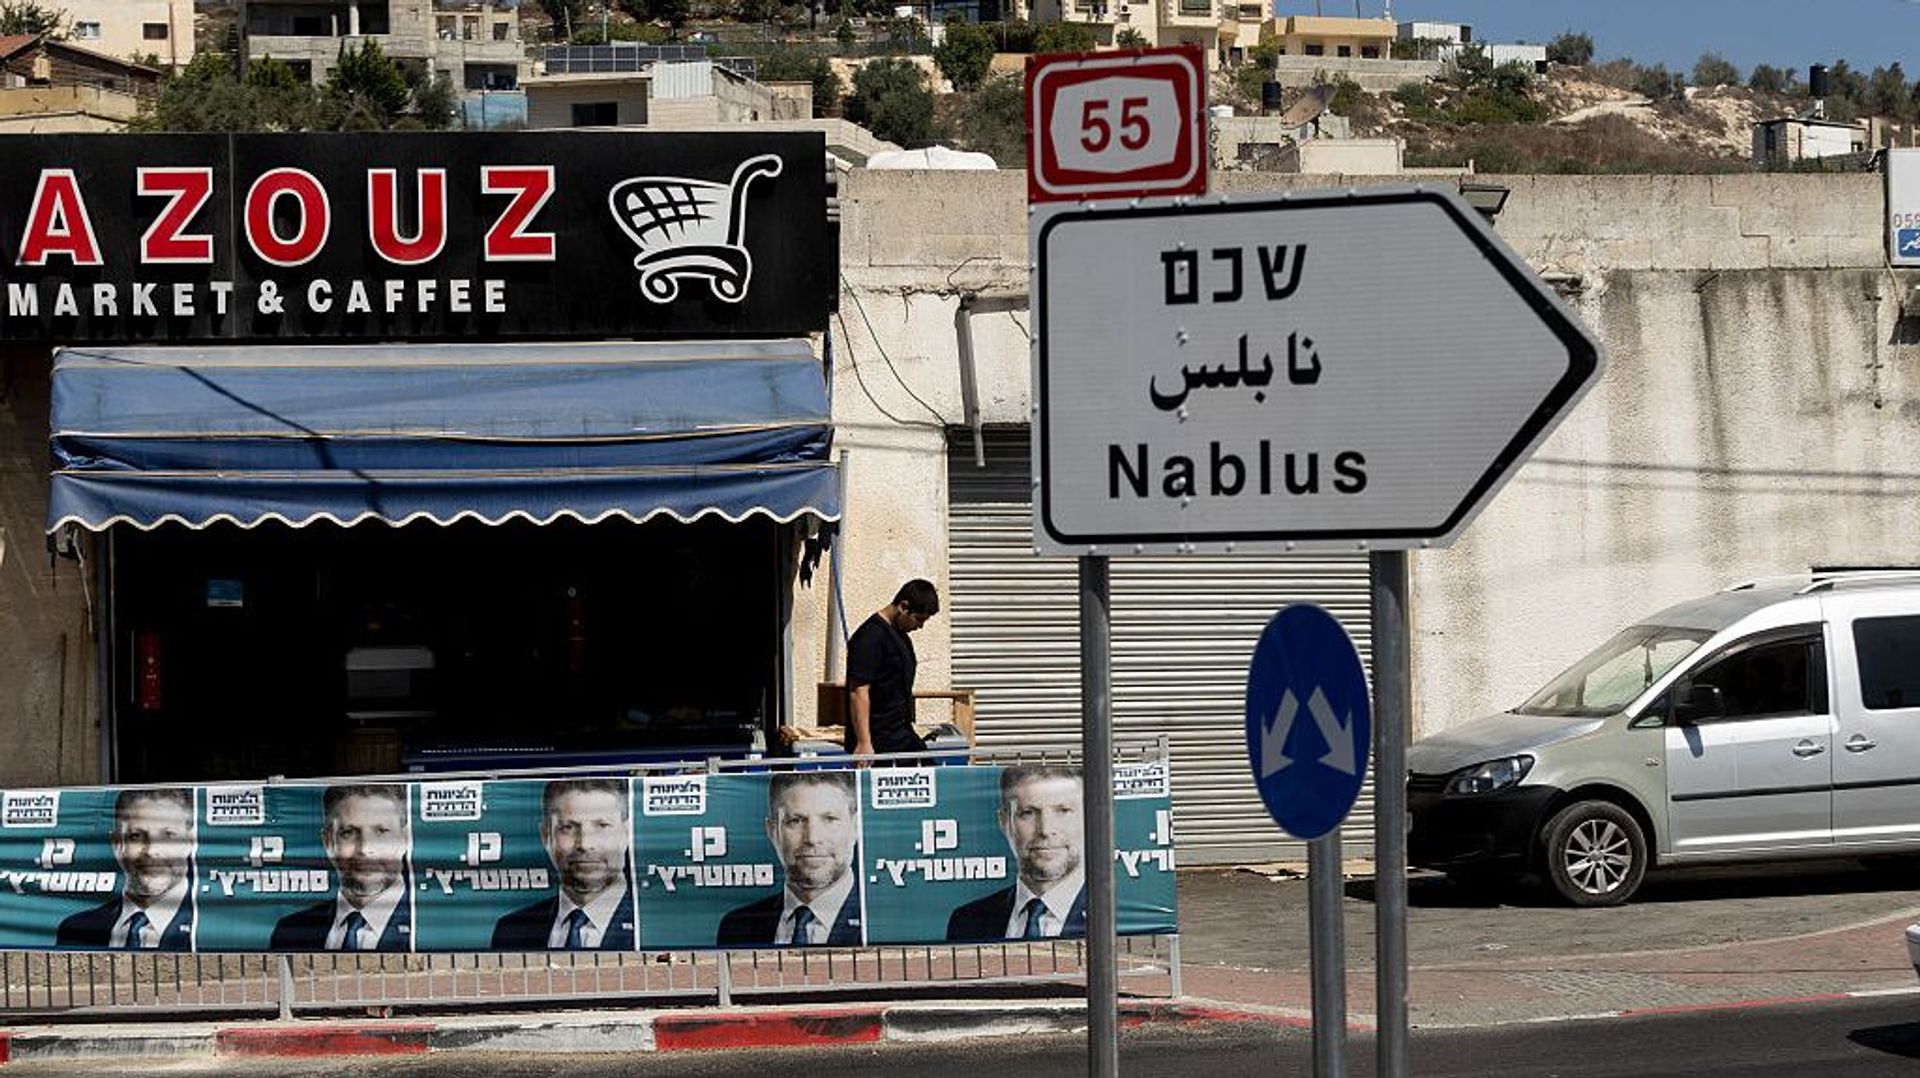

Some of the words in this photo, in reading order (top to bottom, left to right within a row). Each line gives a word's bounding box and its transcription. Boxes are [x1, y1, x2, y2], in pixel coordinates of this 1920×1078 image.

[1080, 97, 1150, 153] 55
[15, 166, 556, 266] AZOUZ
[7, 281, 233, 316] MARKET
[257, 279, 285, 314] &
[307, 278, 506, 313] CAFFEE
[1160, 244, 1307, 305] שכם
[1149, 331, 1322, 411] نابلس
[1108, 439, 1368, 498] Nablus
